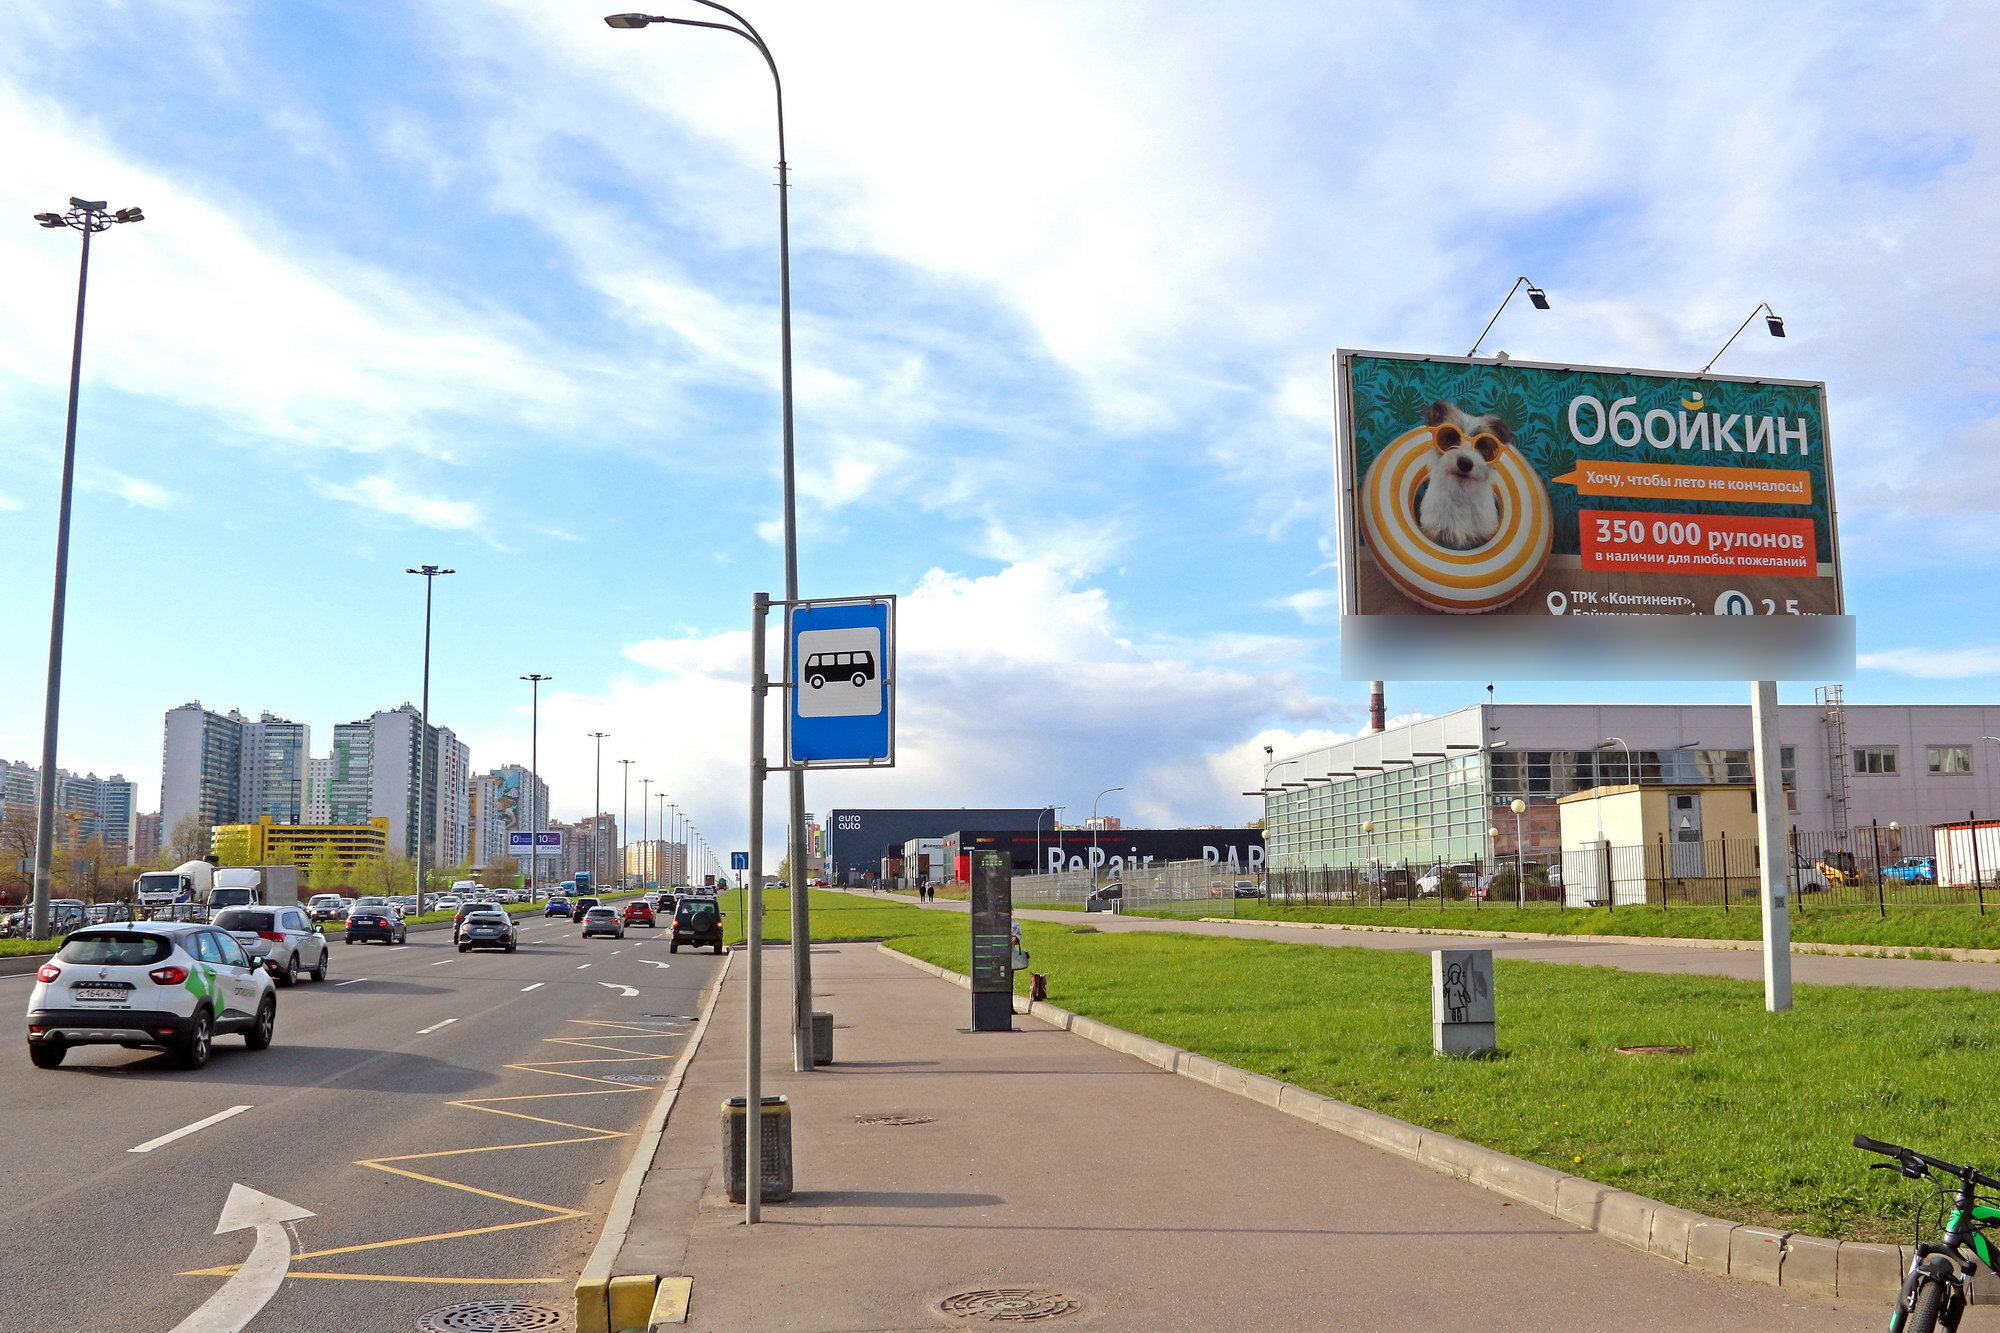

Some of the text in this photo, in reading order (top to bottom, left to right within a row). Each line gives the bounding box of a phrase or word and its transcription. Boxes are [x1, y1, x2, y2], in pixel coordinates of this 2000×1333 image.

[1568, 391, 1808, 455] Обойкин
[1586, 471, 1804, 493] Хочу, чтобы лето не кончалось!
[1596, 519, 1804, 551] 350 000 рулонов
[1595, 552, 1807, 567] в наличии для любых пожеланий
[1570, 591, 1696, 608] ТРК «Континент»,
[838, 814, 861, 822] euro
[838, 821, 861, 830] auto
[538, 835, 548, 843] 10
